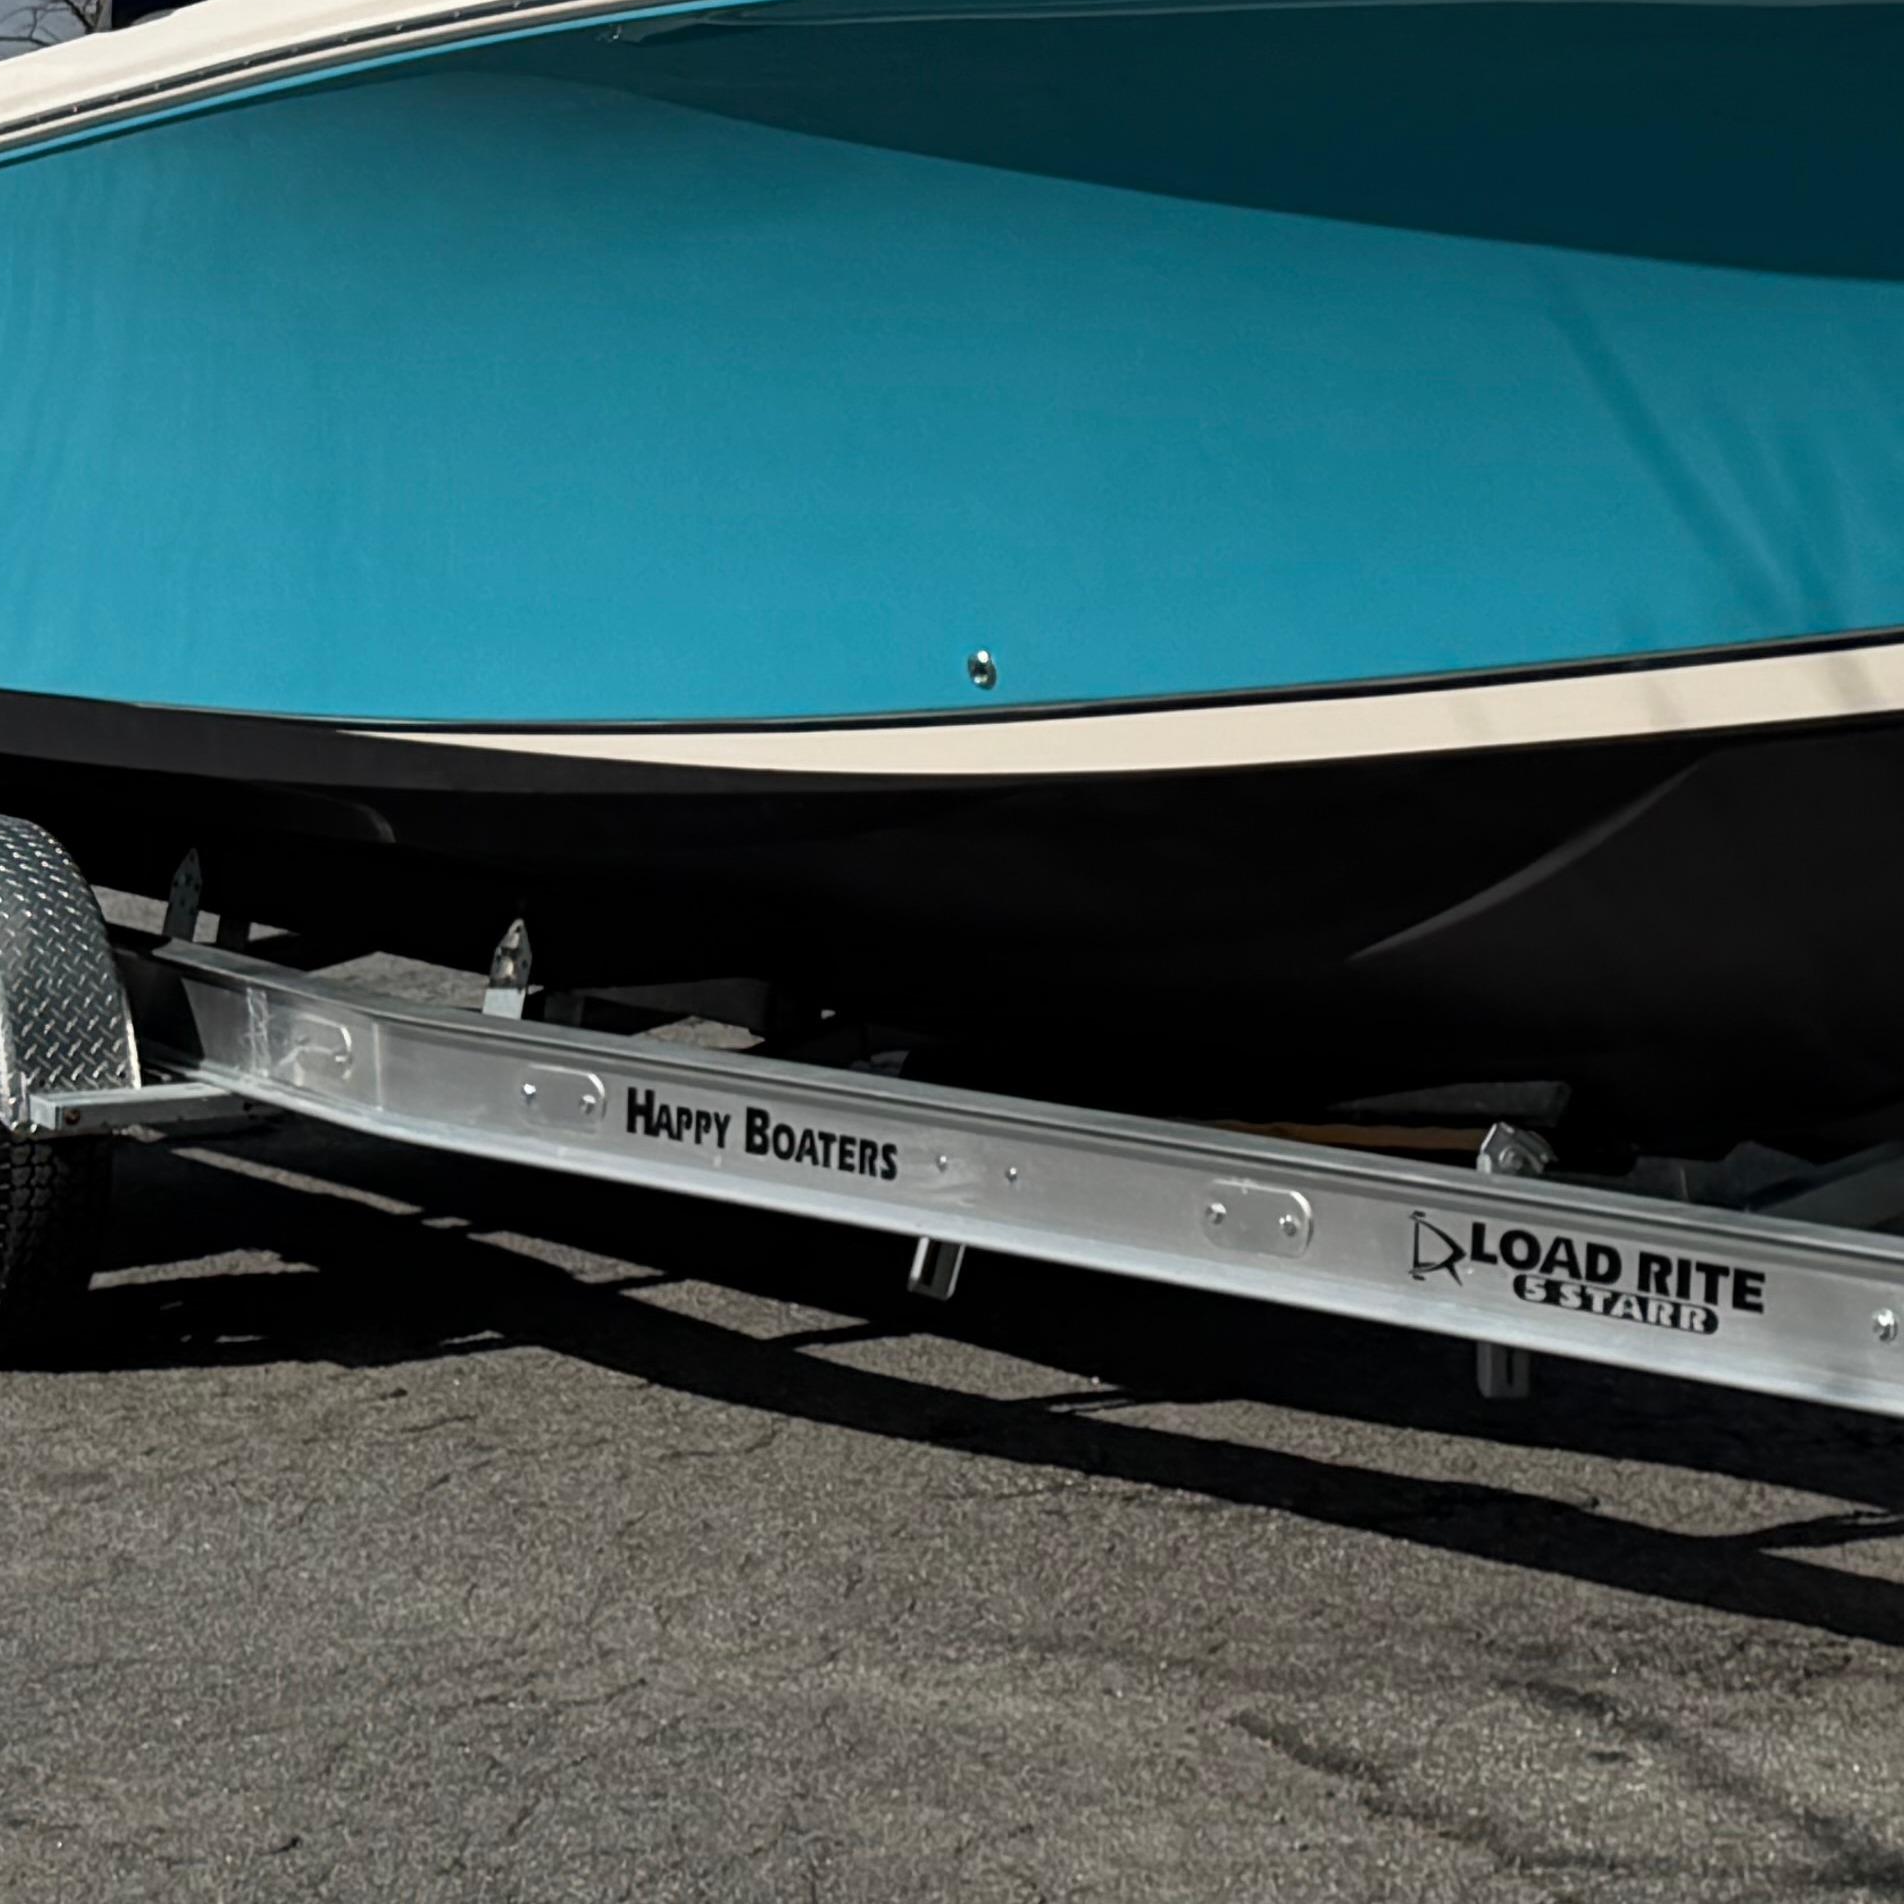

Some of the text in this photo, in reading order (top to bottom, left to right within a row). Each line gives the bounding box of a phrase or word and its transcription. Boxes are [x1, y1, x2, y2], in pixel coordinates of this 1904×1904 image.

[1470, 1222, 1766, 1314] LOAD RITE
[1523, 1274, 1709, 1333] 5 STARR
